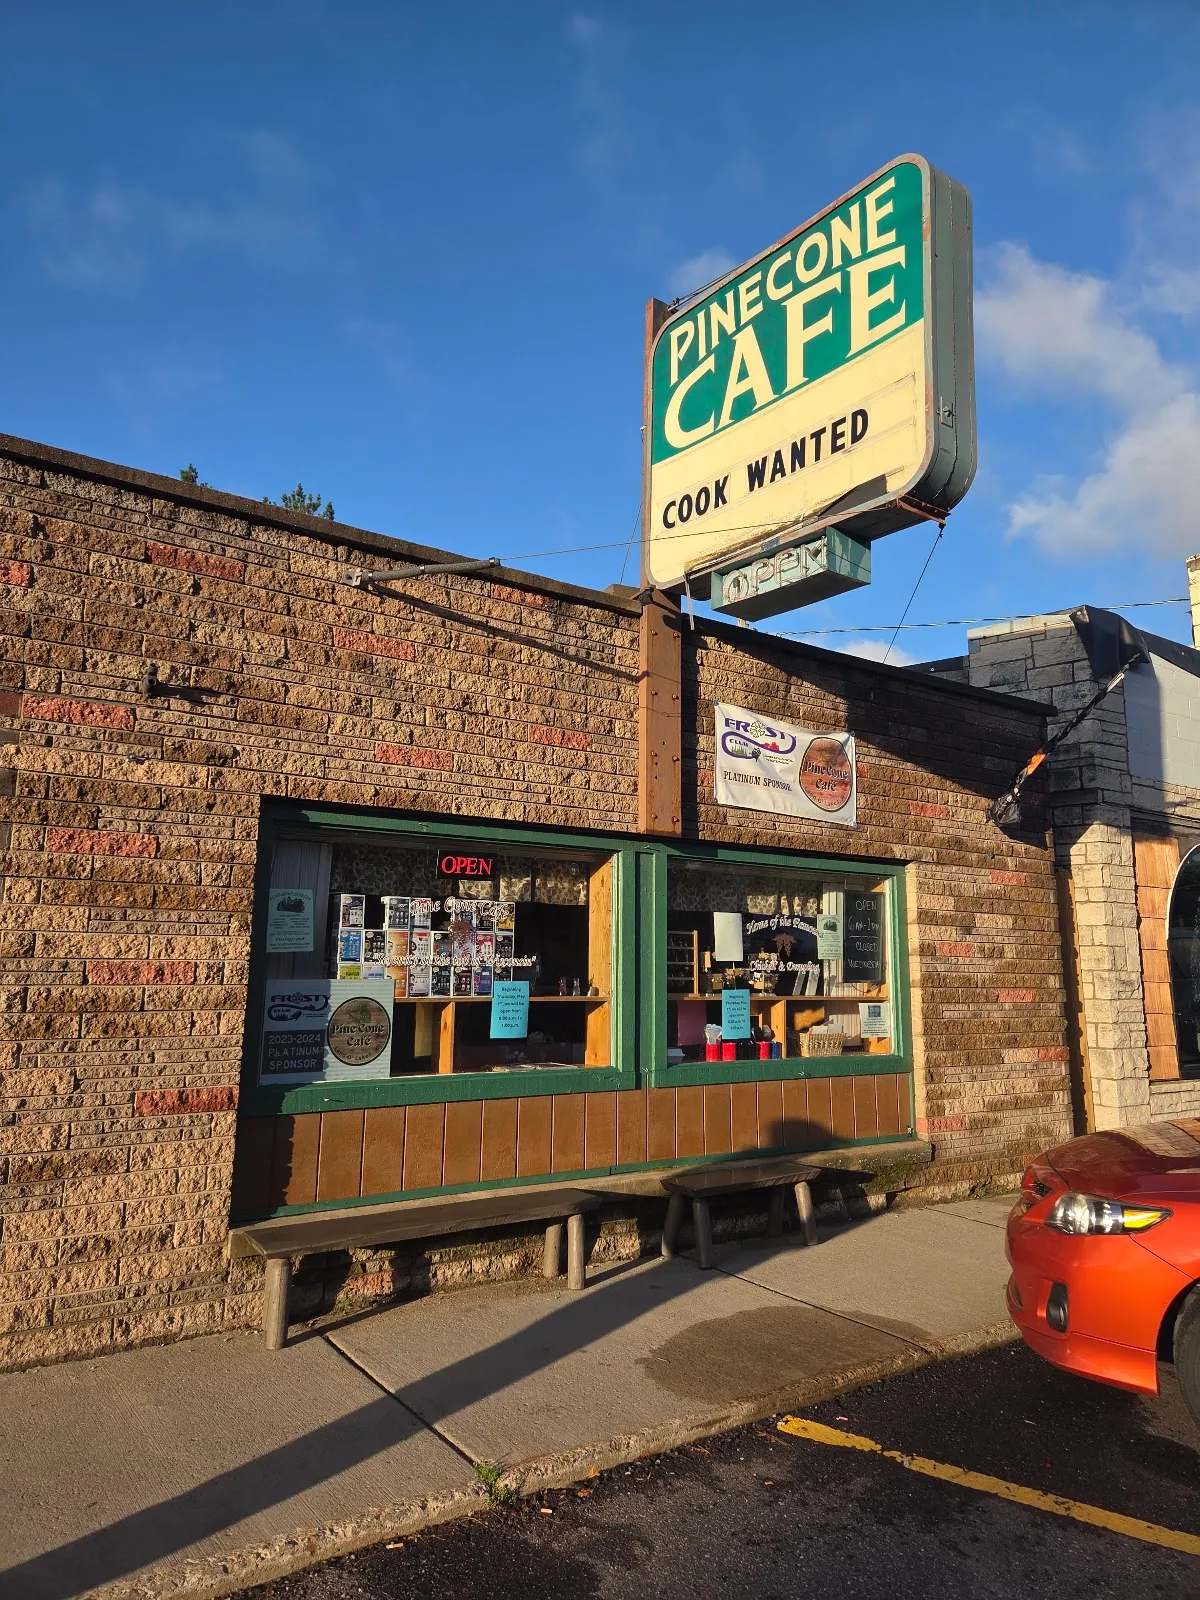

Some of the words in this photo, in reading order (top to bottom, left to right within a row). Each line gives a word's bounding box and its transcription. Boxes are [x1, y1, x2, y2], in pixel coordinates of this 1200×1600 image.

[670, 177, 897, 387] PINECONE
[664, 246, 907, 450] CAFE
[662, 474, 729, 529] COOK
[747, 408, 869, 492] WANTED
[722, 535, 827, 602] OPEN
[723, 771, 761, 786] PLATINUM
[763, 777, 793, 791] SPONSOR
[441, 856, 494, 875] OPEN
[409, 900, 441, 916] Pine
[856, 900, 877, 911] OPEN
[770, 914, 779, 930] of
[780, 916, 791, 926] the
[856, 941, 879, 952] CLOSED
[779, 961, 785, 971] &
[332, 1024, 356, 1035] Pine
[358, 1023, 385, 1034] Cone
[268, 1033, 320, 1045] 2023-2024
[268, 1047, 320, 1057] PLATINUM
[269, 1059, 318, 1071] SPONSOR
